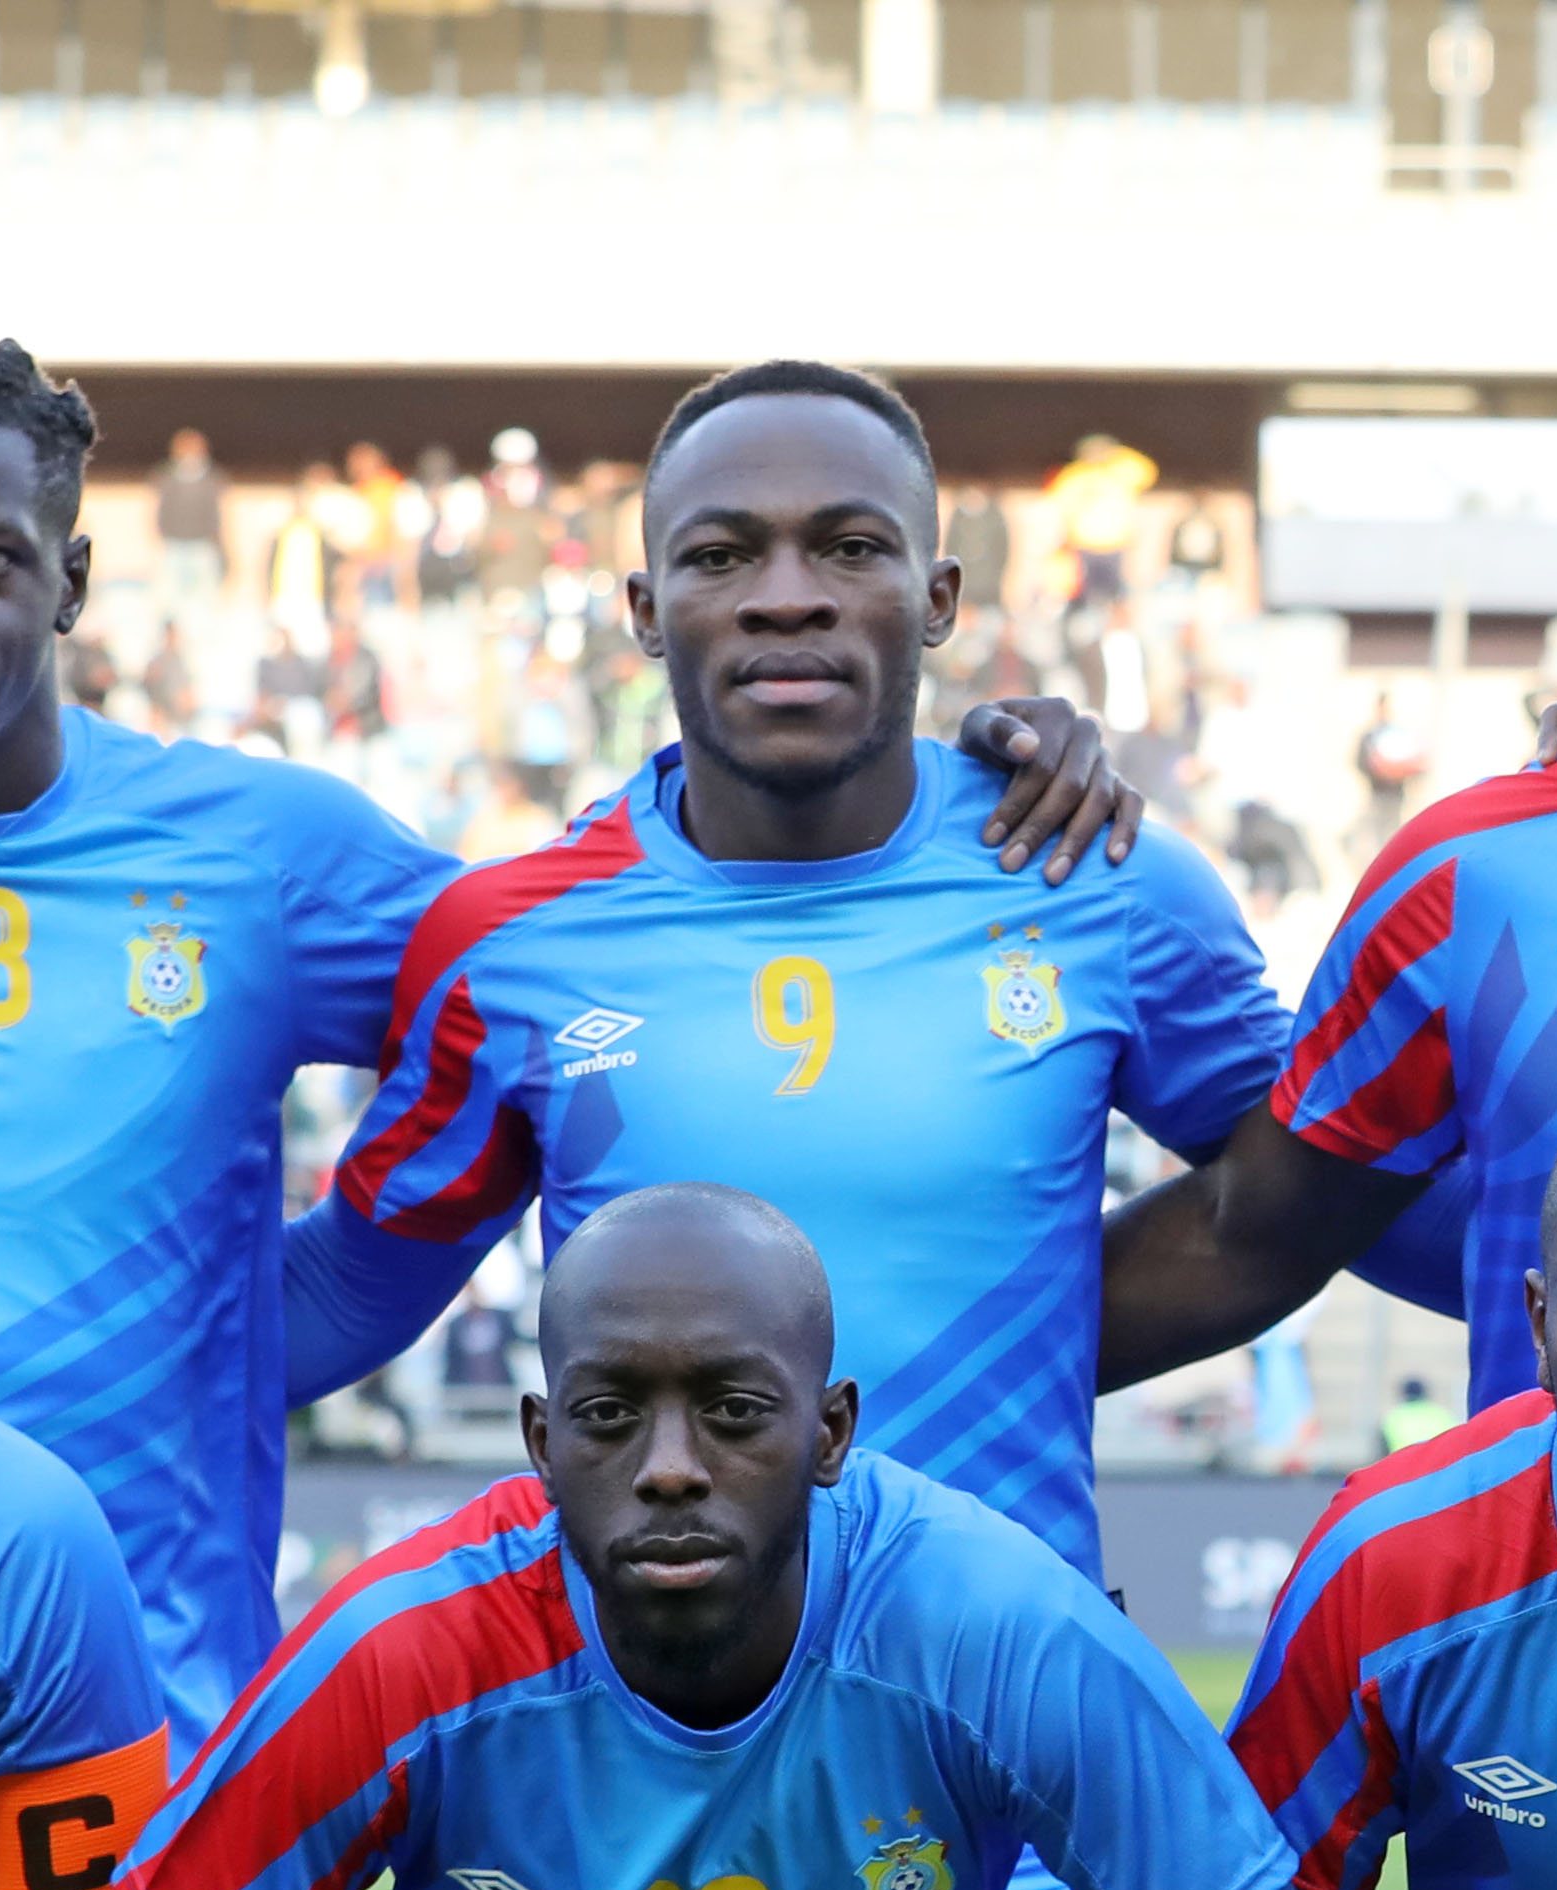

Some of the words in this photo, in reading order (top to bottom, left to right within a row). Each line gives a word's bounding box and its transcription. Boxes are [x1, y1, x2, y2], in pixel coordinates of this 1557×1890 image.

[752, 955, 836, 1096] 9
[1000, 1019, 1055, 1041] FECOFA
[563, 1049, 637, 1078] umbro
[1465, 1794, 1546, 1828] umbro
